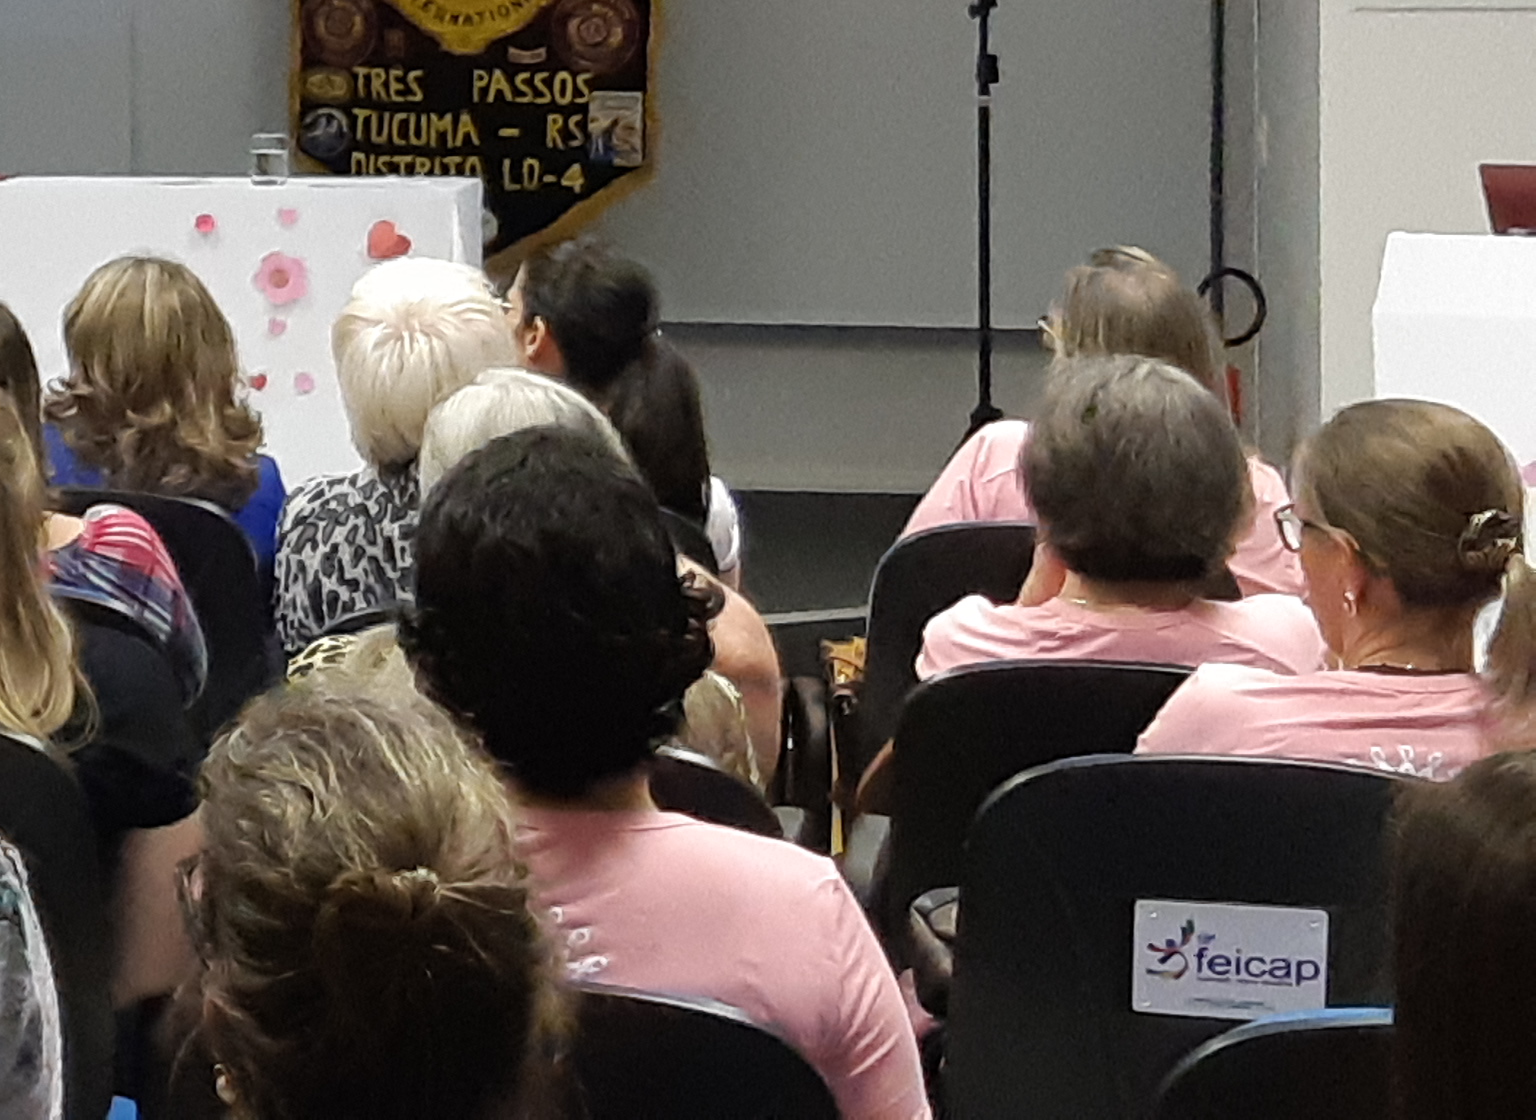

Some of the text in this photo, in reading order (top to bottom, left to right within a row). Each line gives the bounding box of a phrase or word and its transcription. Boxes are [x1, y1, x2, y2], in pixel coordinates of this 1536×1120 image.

[472, 68, 594, 106] PASSOS
[545, 113, 585, 150] RS
[502, 157, 585, 194] LD-4
[1193, 946, 1321, 987] feicap
